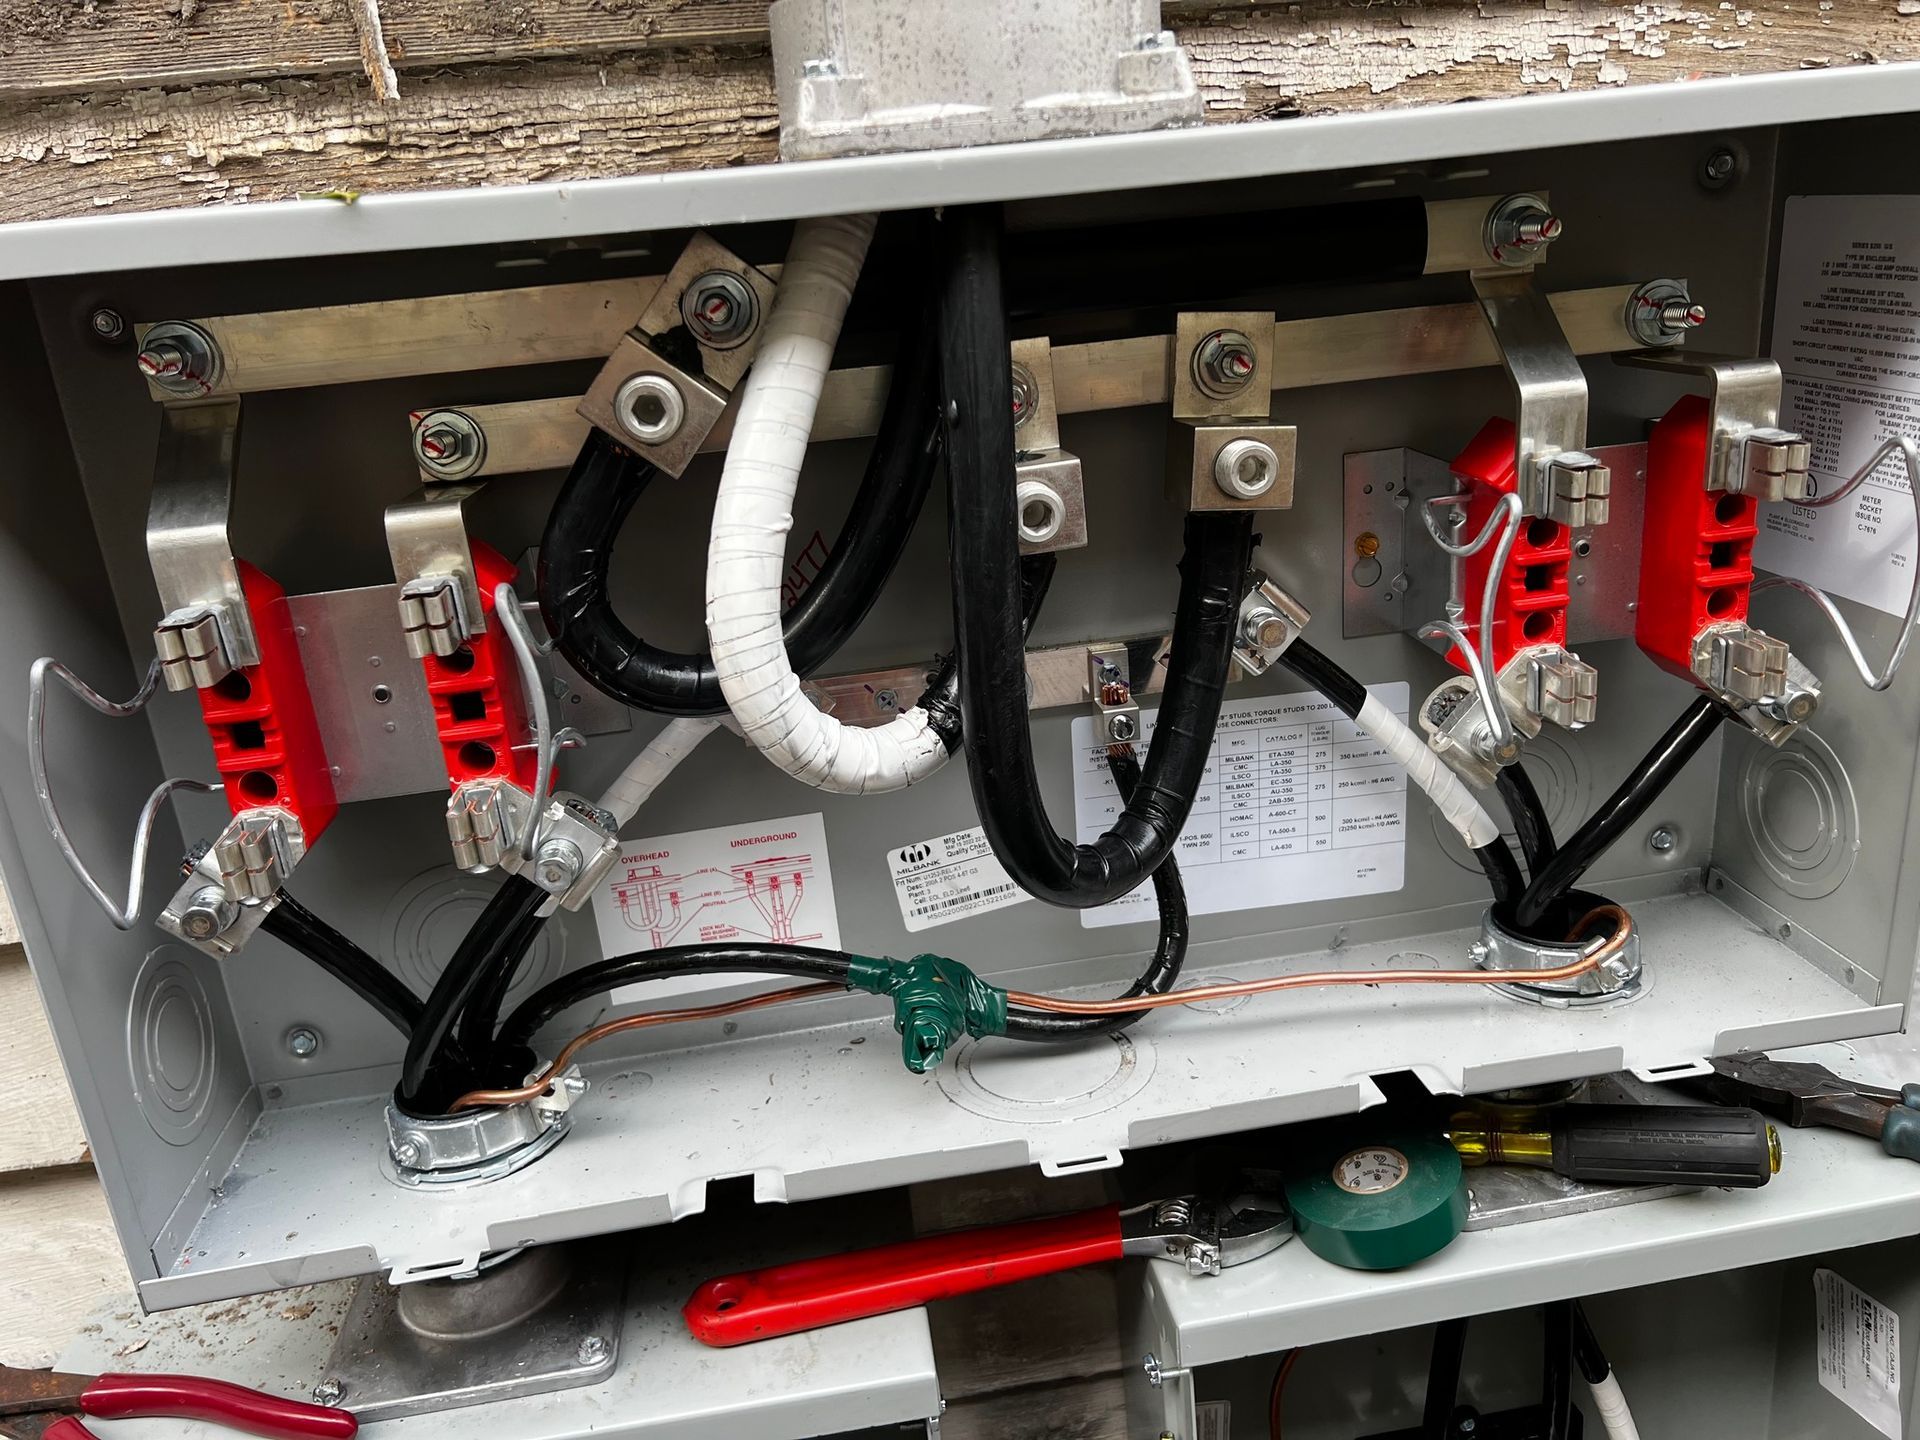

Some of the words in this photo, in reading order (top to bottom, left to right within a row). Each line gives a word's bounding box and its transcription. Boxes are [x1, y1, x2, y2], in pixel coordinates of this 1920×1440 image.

[1825, 384, 1845, 394] CONDUIT
[1857, 389, 1879, 399] OPENING
[1880, 393, 1894, 401] MUST
[1820, 400, 1841, 408] OPENING
[1822, 391, 1831, 399] THE
[1832, 393, 1860, 404] FOLLOWING
[1861, 398, 1887, 408] APPROVED
[1794, 403, 1813, 412] MILBANK
[1875, 409, 1885, 417] FOR
[1886, 411, 1903, 420] LARGE
[1879, 419, 1901, 428] MILBANK
[1893, 463, 1905, 471] Plate
[1862, 495, 1882, 505] METER
[1859, 503, 1882, 514] SOCKET
[1855, 512, 1870, 521] ISSUE
[1231, 718, 1278, 726] CONNECTORS:
[1266, 734, 1297, 743] CATALOG
[1269, 750, 1295, 758] ETA-350
[1225, 755, 1254, 763] MILBANK
[1225, 782, 1254, 790] MILBANK
[1270, 787, 1293, 795] AU-350
[1231, 792, 1251, 800] ILSCO
[1268, 797, 1295, 805] 2AB-350
[1268, 809, 1296, 817] A-600-CT
[1230, 814, 1254, 822] HOMAC
[730, 832, 797, 848] UNDERGROUND
[943, 836, 956, 844] Mfg
[946, 846, 968, 857] Quality
[1271, 843, 1292, 851] LA-630
[621, 851, 670, 864] OVERHEAD
[897, 859, 941, 875] MILBANK
[1890, 1372, 1895, 1383] NO
